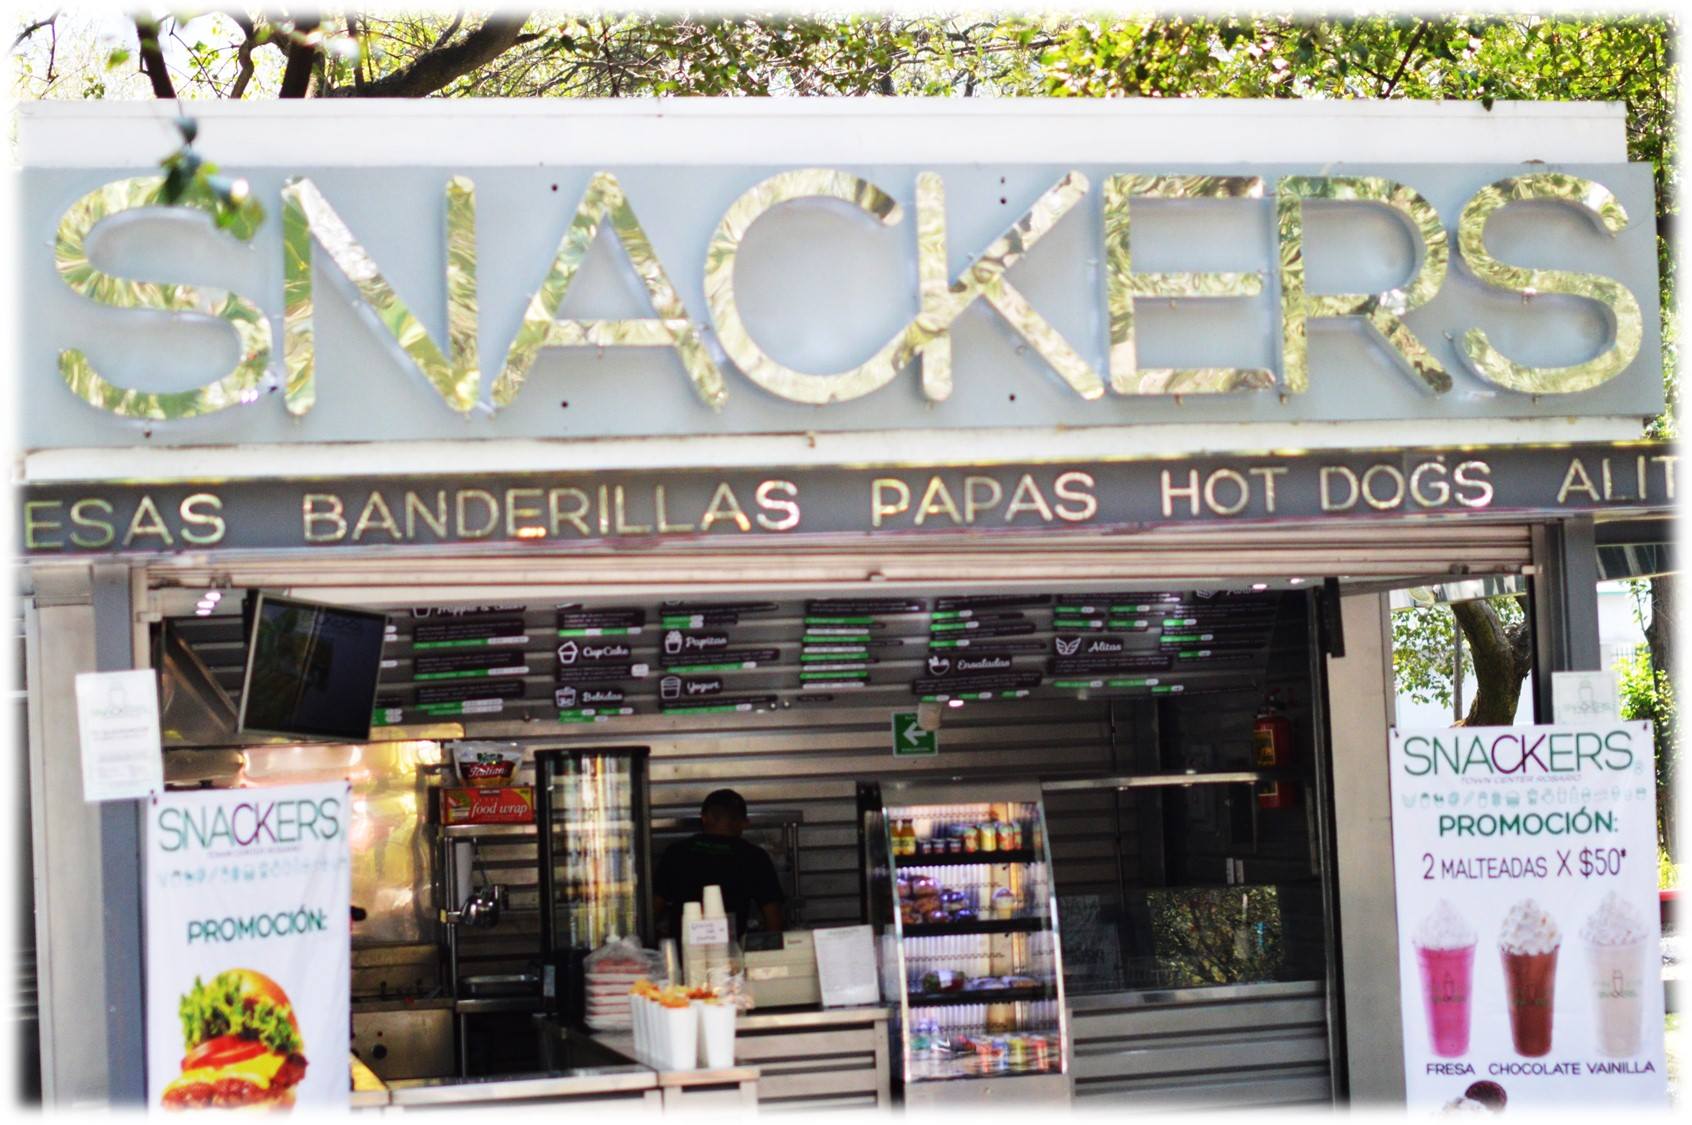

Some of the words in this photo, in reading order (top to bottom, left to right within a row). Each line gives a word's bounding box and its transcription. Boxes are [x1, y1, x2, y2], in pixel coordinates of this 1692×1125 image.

[54, 168, 1644, 424] SNACKERS
[24, 493, 226, 548] ESAS
[302, 480, 800, 543] BANDERILLAS
[871, 471, 1097, 527] PAPAS
[1160, 465, 1289, 517] HOT
[1319, 460, 1494, 511] DOGS
[1404, 730, 1634, 776] SNACKERS
[158, 797, 340, 852] SNACKERS
[471, 800, 498, 819] food
[499, 804, 528, 817] wrap
[1439, 805, 1619, 837] PROMOCIÓN:
[1423, 853, 1435, 880] 2
[1441, 856, 1548, 880] MALTEADAS
[1556, 849, 1572, 877] X
[187, 903, 328, 945] PROMOCIÓN:
[1426, 1062, 1476, 1076] FRESA
[1488, 1062, 1581, 1076] CHOCOLATE
[1586, 1061, 1656, 1075] VAINILLA
